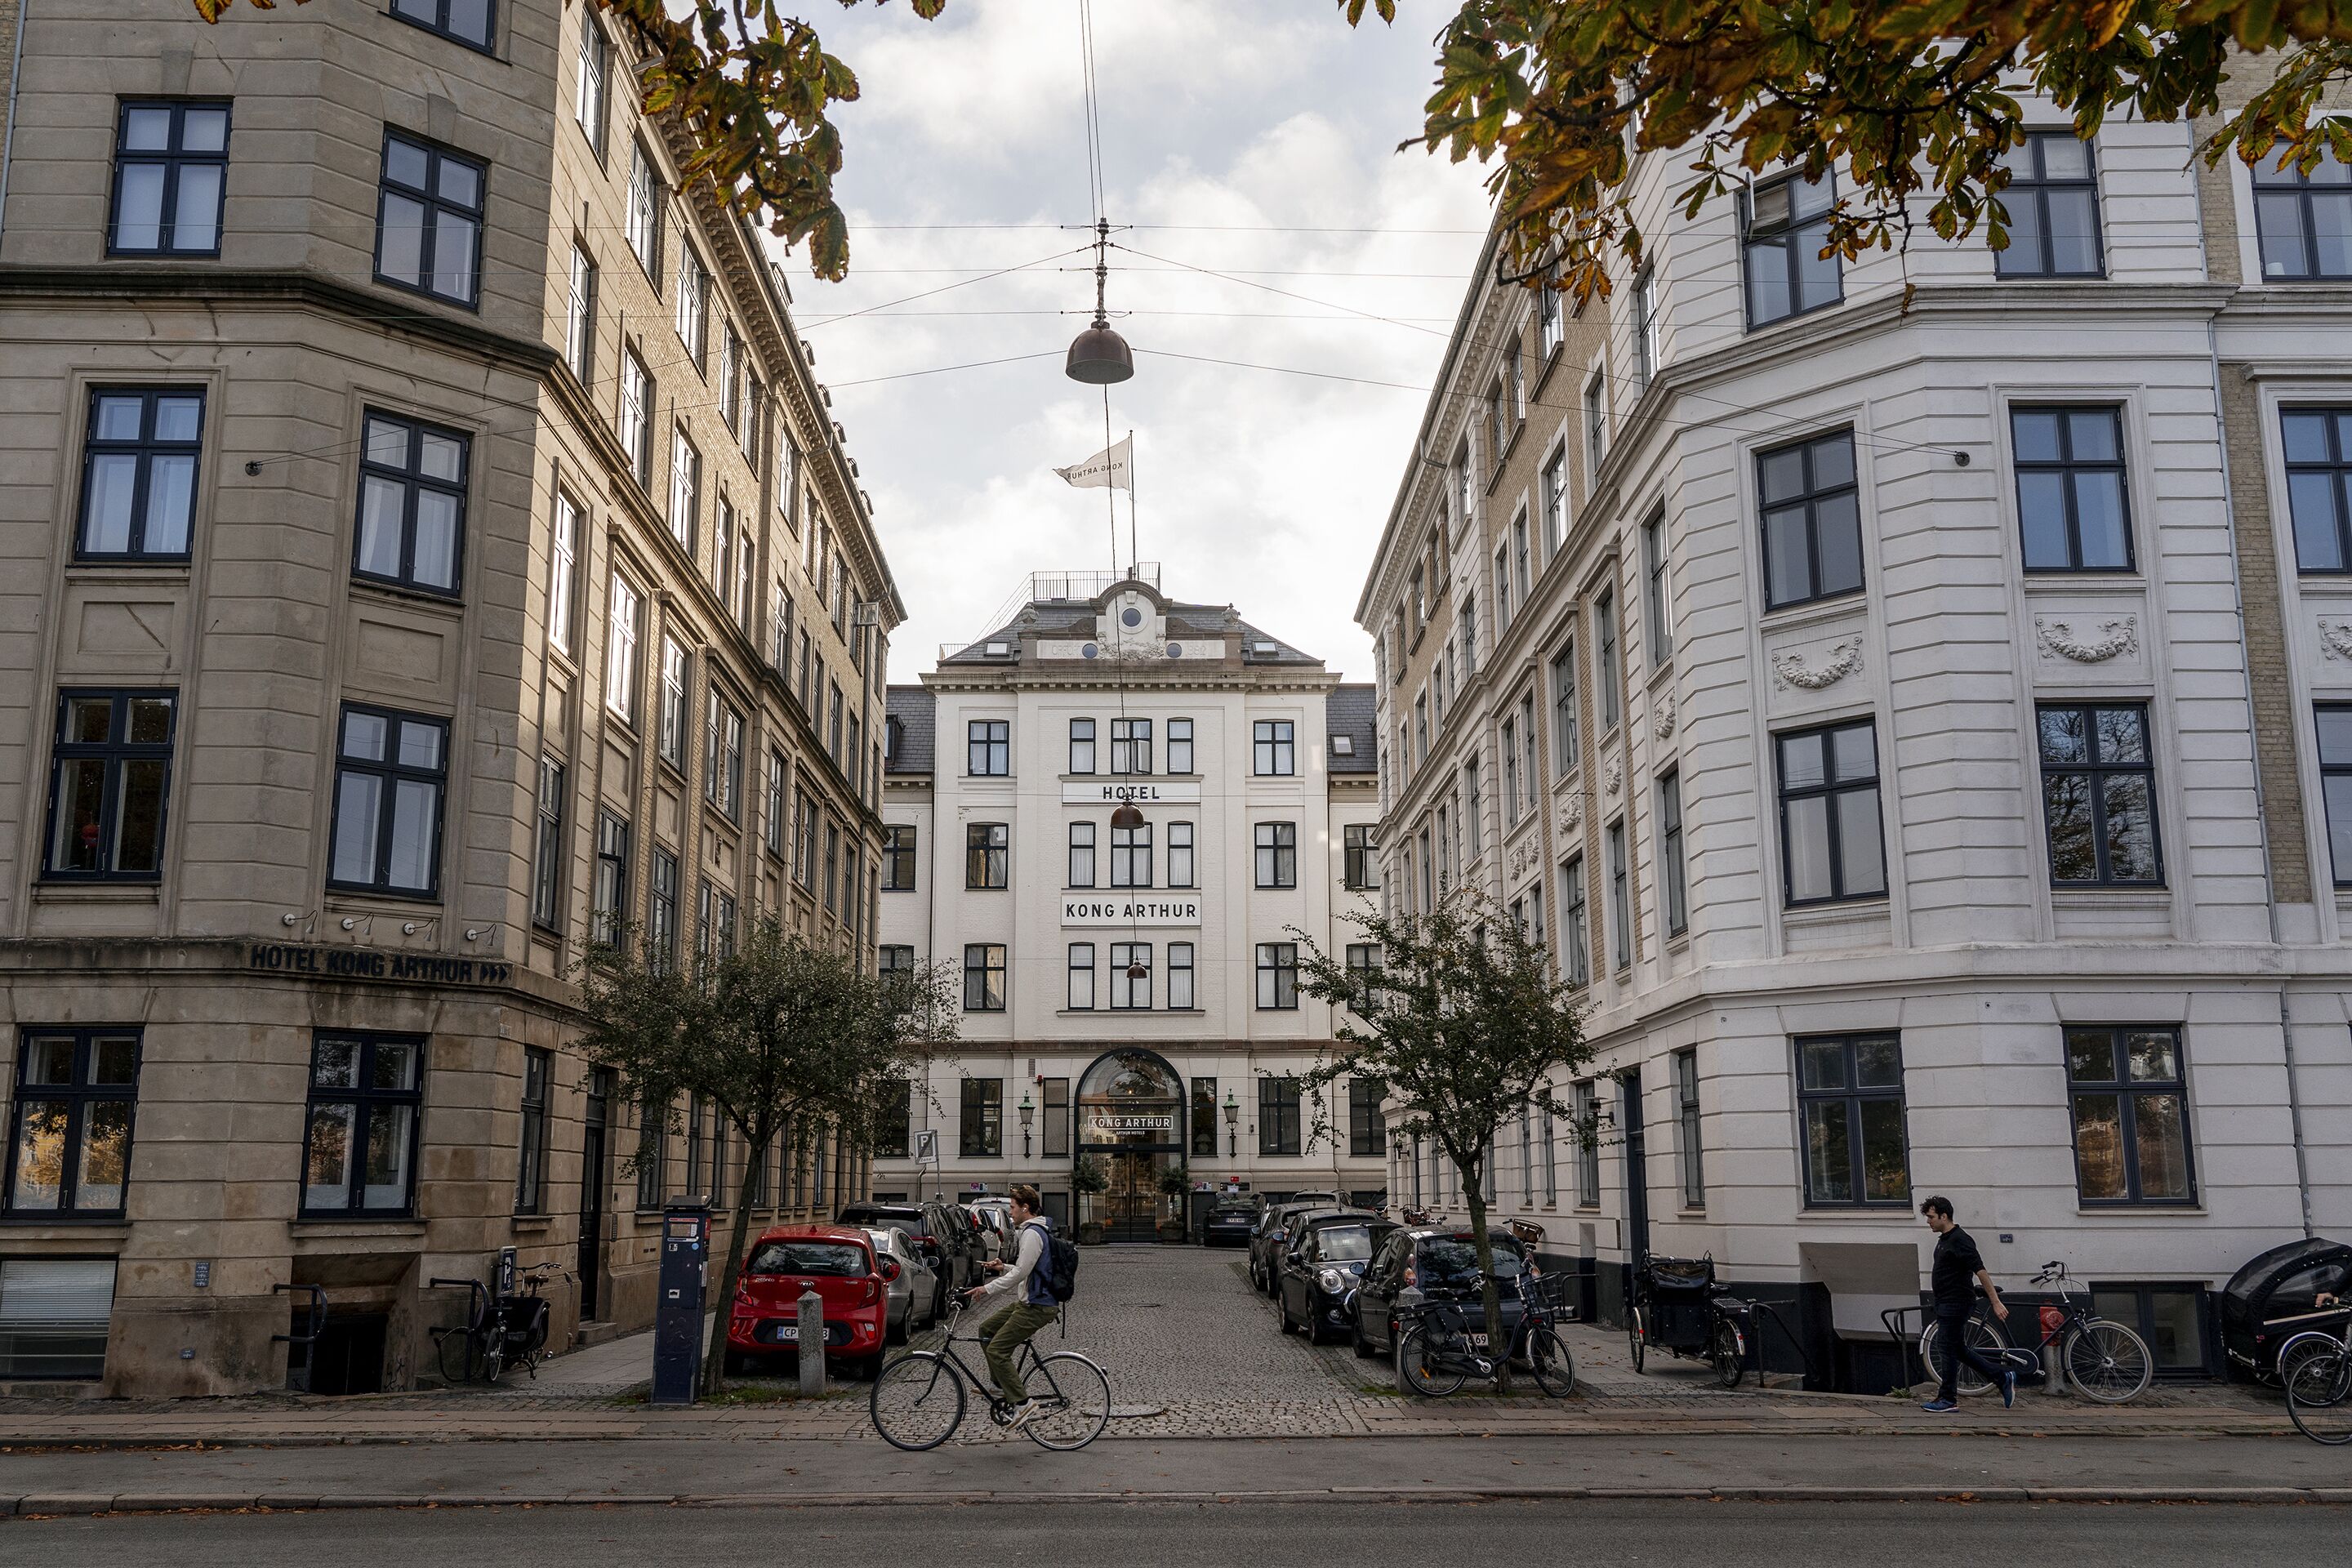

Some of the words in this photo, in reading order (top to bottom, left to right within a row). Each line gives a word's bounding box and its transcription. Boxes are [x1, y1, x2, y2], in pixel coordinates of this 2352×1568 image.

[1102, 786, 1160, 800] HOTEL
[1067, 904, 1115, 917] KONG
[1124, 904, 1196, 917] ARTHUR
[250, 946, 319, 971] HOTEL
[327, 951, 384, 977] KONG
[391, 956, 472, 982] ARTHUR
[1091, 1119, 1121, 1127] KONG
[1125, 1119, 1170, 1127] ARTHUR
[921, 1136, 929, 1147] P
[784, 1328, 796, 1337] CP
